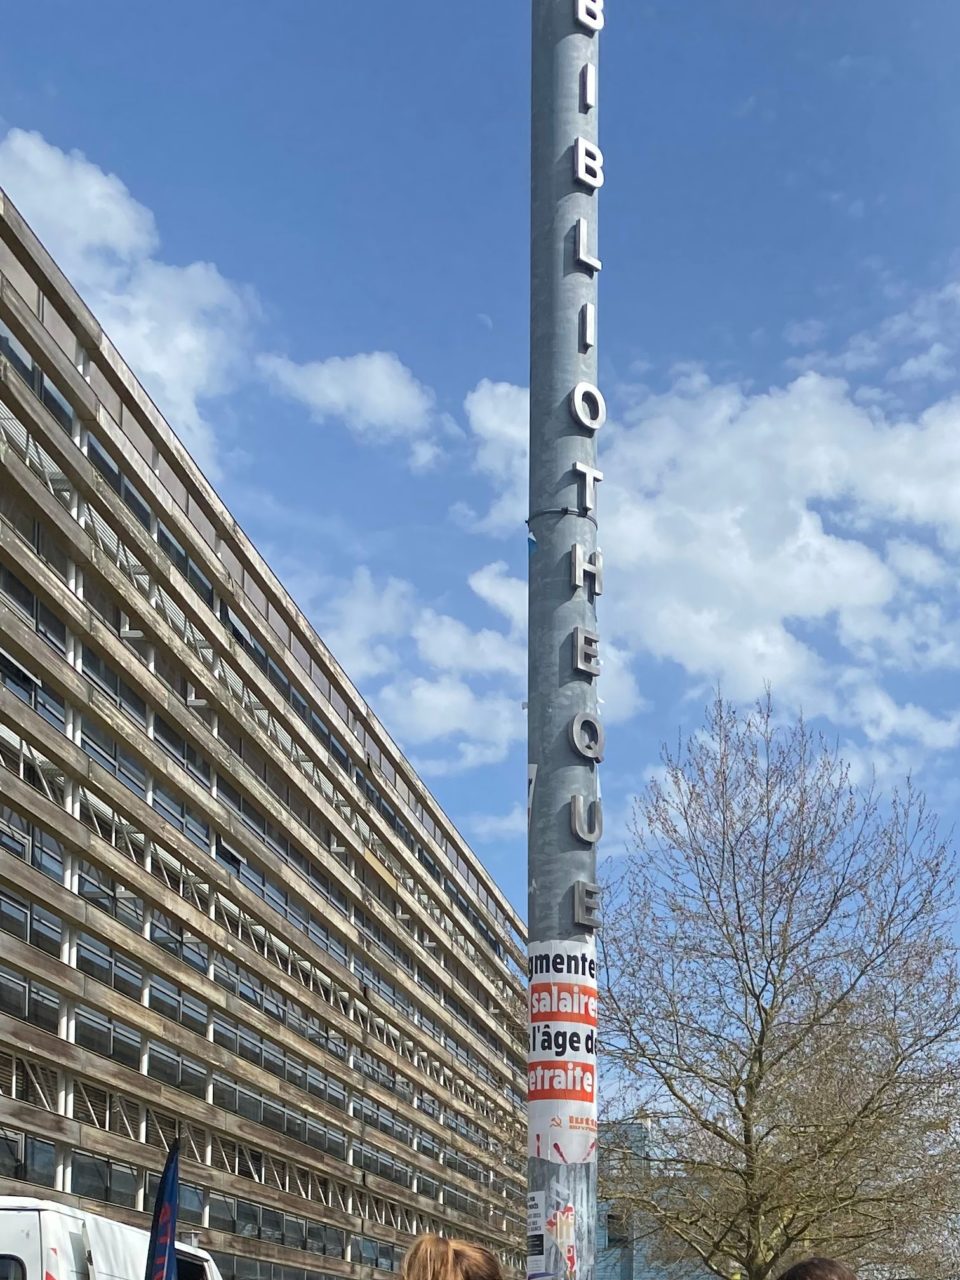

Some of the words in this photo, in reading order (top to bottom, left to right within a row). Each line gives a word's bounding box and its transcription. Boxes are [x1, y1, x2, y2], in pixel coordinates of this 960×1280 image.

[568, 0, 607, 930] BIBLIOTHEQUE
[529, 952, 598, 983] gmente
[532, 985, 598, 1020] salaire
[532, 1025, 581, 1057] l'âge
